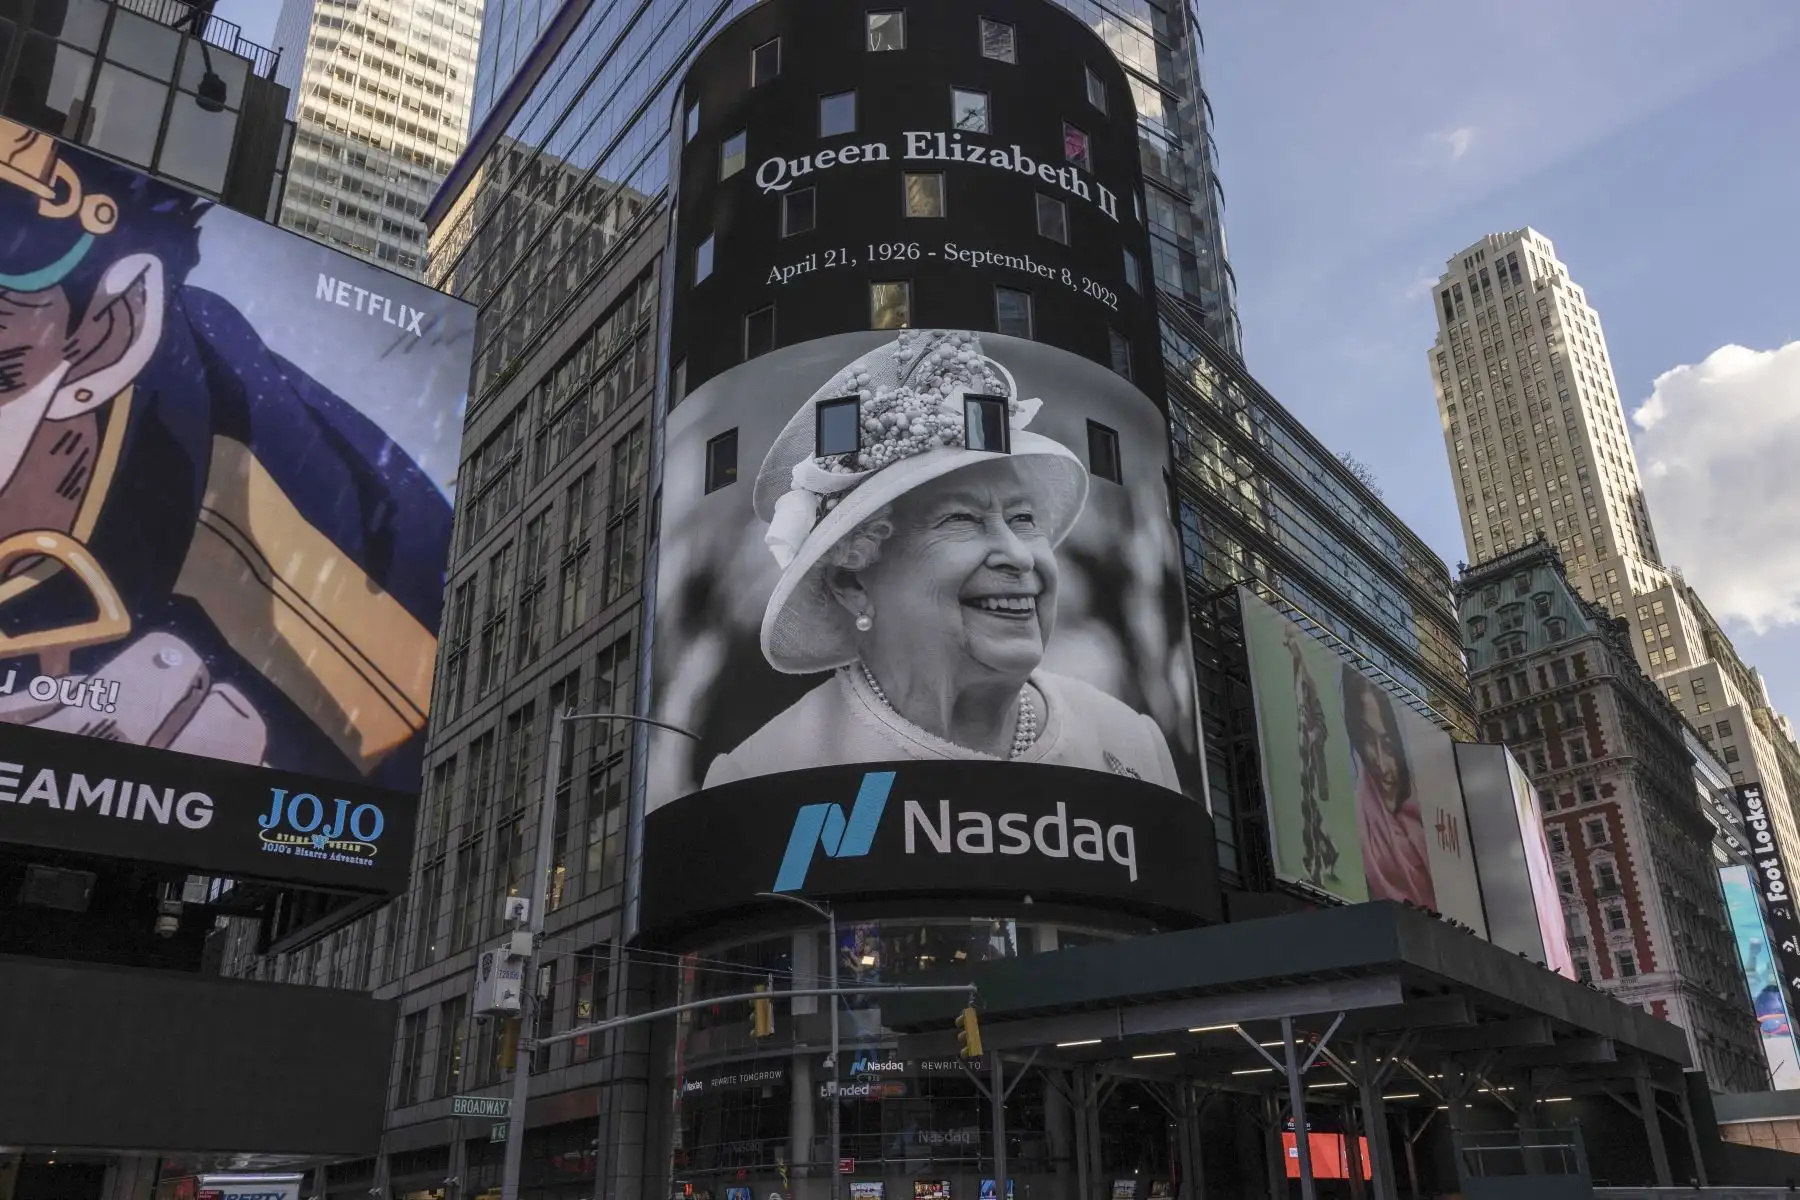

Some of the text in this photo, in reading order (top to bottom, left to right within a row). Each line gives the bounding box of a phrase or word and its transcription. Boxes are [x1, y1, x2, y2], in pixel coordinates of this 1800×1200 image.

[755, 131, 1119, 224] Queen Elizabeth II
[766, 253, 818, 285] April
[824, 247, 857, 268] 21,
[867, 242, 921, 261] 1926
[944, 243, 1057, 279] September
[1060, 268, 1078, 292] 8,
[1082, 276, 1118, 312] 2022
[315, 273, 426, 337] NETFLIX
[28, 674, 121, 714] out!
[0, 761, 215, 830] EAMING
[258, 787, 384, 842] JOJO
[294, 846, 328, 860] Bizarre
[329, 851, 373, 866] Adventure
[903, 799, 1139, 882] Nasdaq
[1434, 806, 1461, 860] H&M
[1760, 858, 1788, 902] Foot
[740, 1070, 783, 1083] TOMORROW
[867, 1060, 904, 1072] Nasdaq
[453, 1099, 506, 1115] BROADWAY
